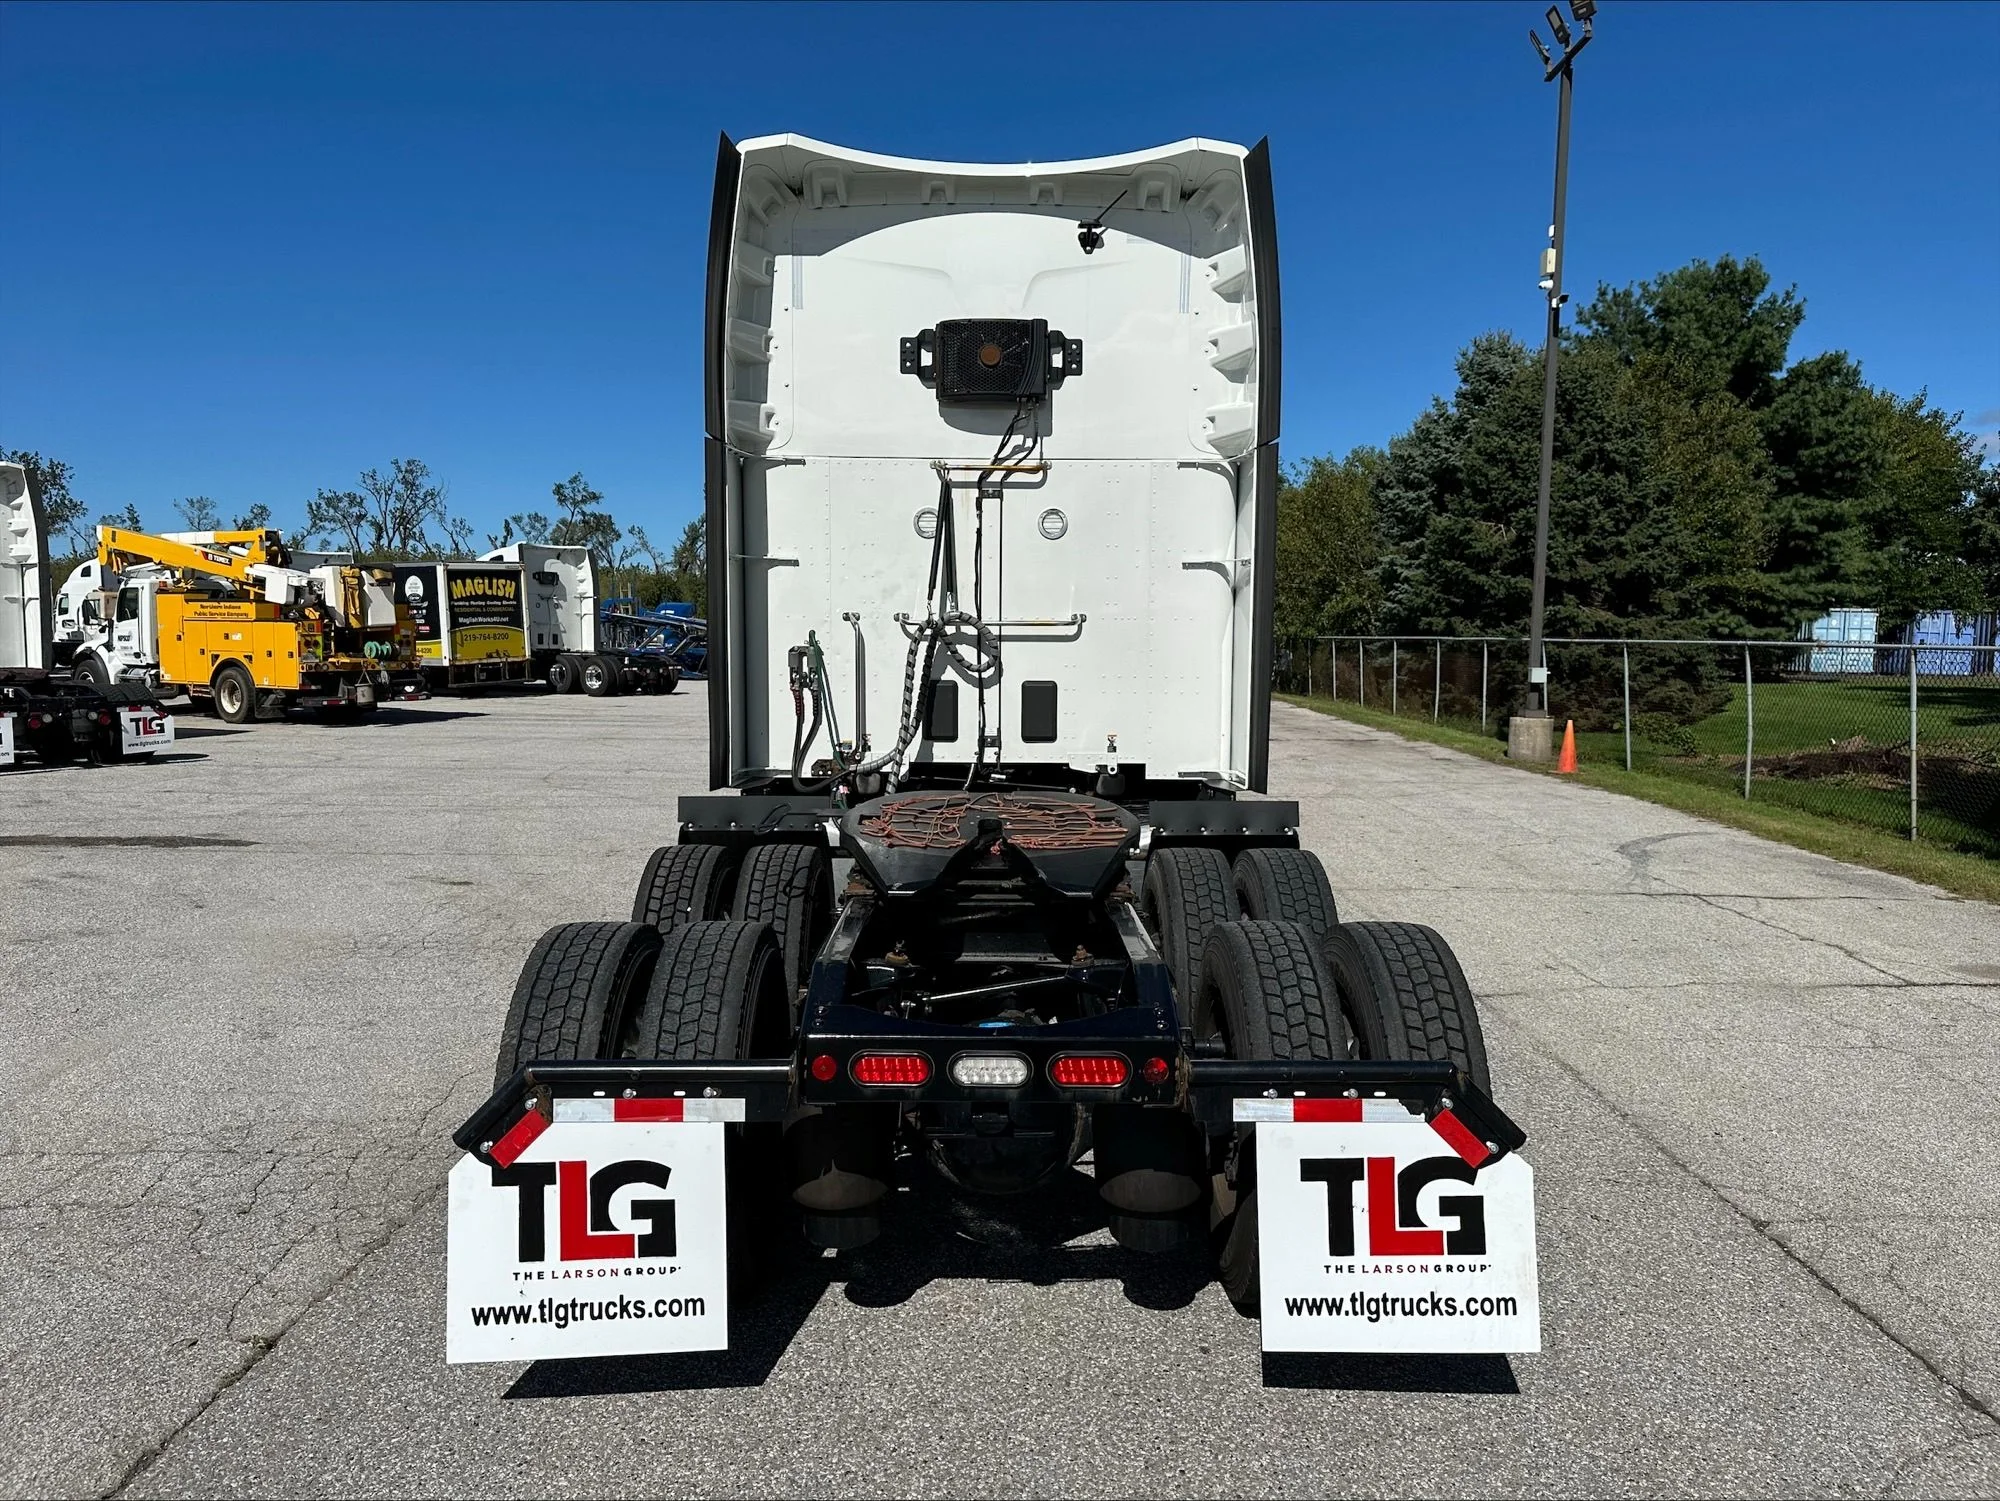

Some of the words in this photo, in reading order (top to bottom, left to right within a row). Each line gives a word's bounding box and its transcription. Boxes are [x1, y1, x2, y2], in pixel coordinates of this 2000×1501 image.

[450, 576, 516, 599] MAGLISH
[464, 632, 509, 641] 219-764-8200
[129, 716, 165, 736] TLG
[492, 1160, 676, 1262] TLG
[1300, 1156, 1486, 1256] TLG
[513, 1271, 545, 1281] THE
[551, 1267, 619, 1279] LARSON
[624, 1266, 678, 1276] GROUP
[1324, 1264, 1355, 1274] THE
[1361, 1264, 1429, 1274] LARSON
[1433, 1264, 1488, 1273] GROUP
[471, 1294, 705, 1329] www.tlgtrucks.com
[1284, 1291, 1517, 1323] www.tlgtrucks.com
